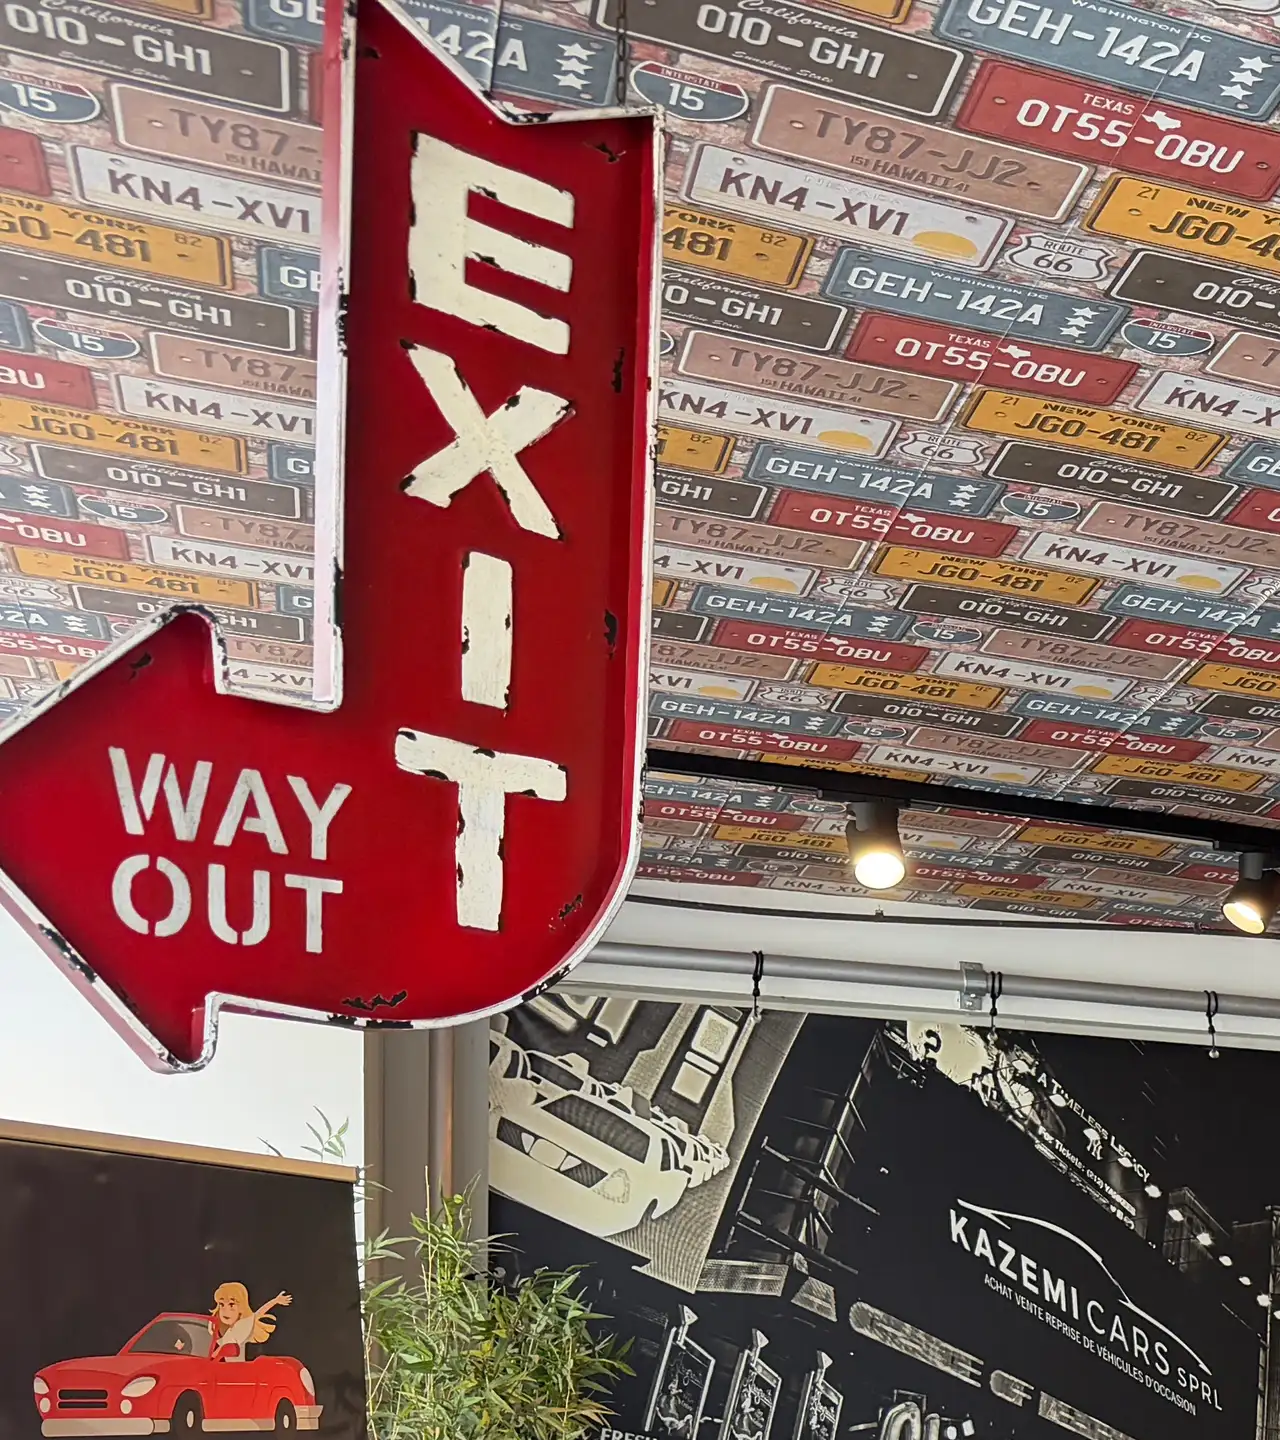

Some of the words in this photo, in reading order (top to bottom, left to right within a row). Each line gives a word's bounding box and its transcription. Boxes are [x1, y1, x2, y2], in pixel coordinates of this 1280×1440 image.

[1081, 94, 1139, 117] TEXAS
[67, 331, 105, 352] 15
[396, 131, 576, 931] EXIT
[109, 746, 351, 860] WAY
[112, 852, 345, 955] OUT
[984, 1273, 1013, 1300] ACHAT
[1014, 1291, 1045, 1322] VENTE
[1044, 1311, 1082, 1344] REPRISE
[1082, 1334, 1096, 1353] DE
[1096, 1346, 1144, 1383] VÉHICULES
[1144, 1374, 1196, 1416] D'OCCASION
[1177, 1368, 1223, 1411] SPRL
